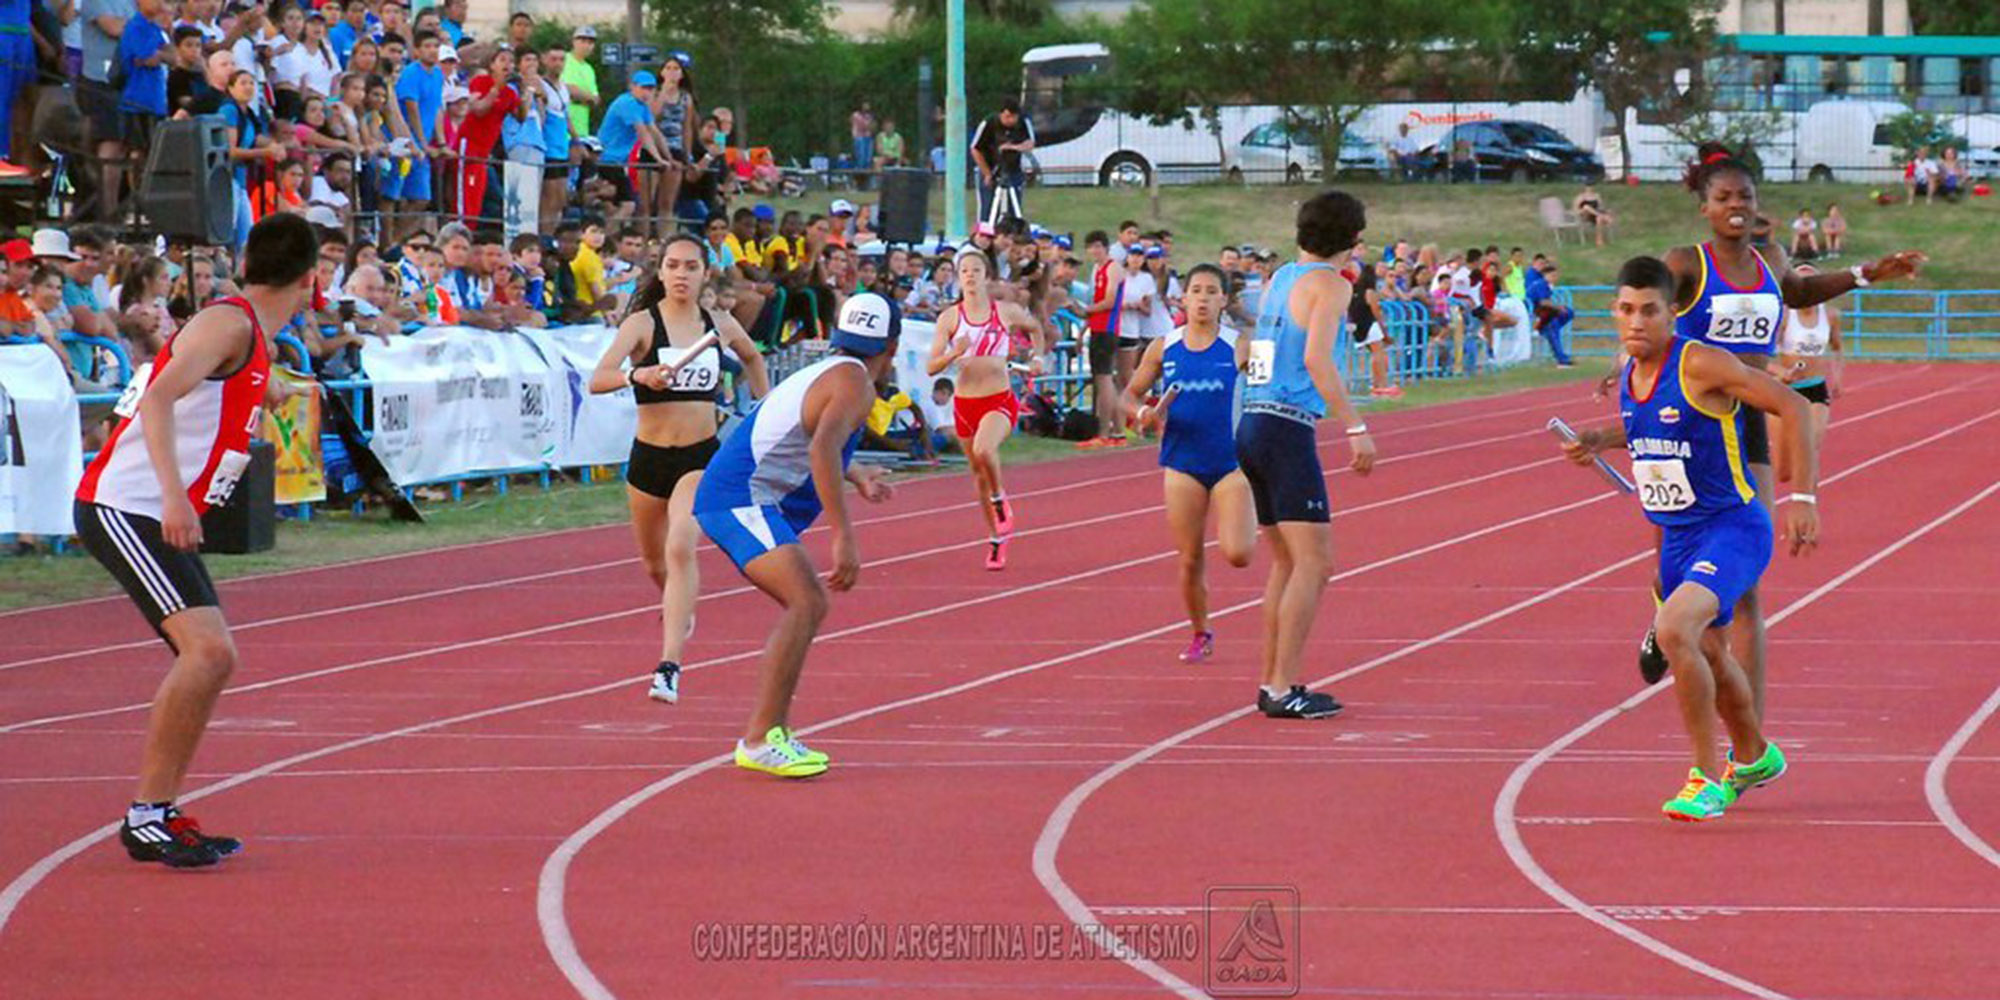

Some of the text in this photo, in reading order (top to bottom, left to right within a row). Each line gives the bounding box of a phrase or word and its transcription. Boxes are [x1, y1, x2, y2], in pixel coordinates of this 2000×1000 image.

[847, 310, 880, 329] UFC
[1715, 317, 1769, 339] 218
[1643, 483, 1687, 505] 202
